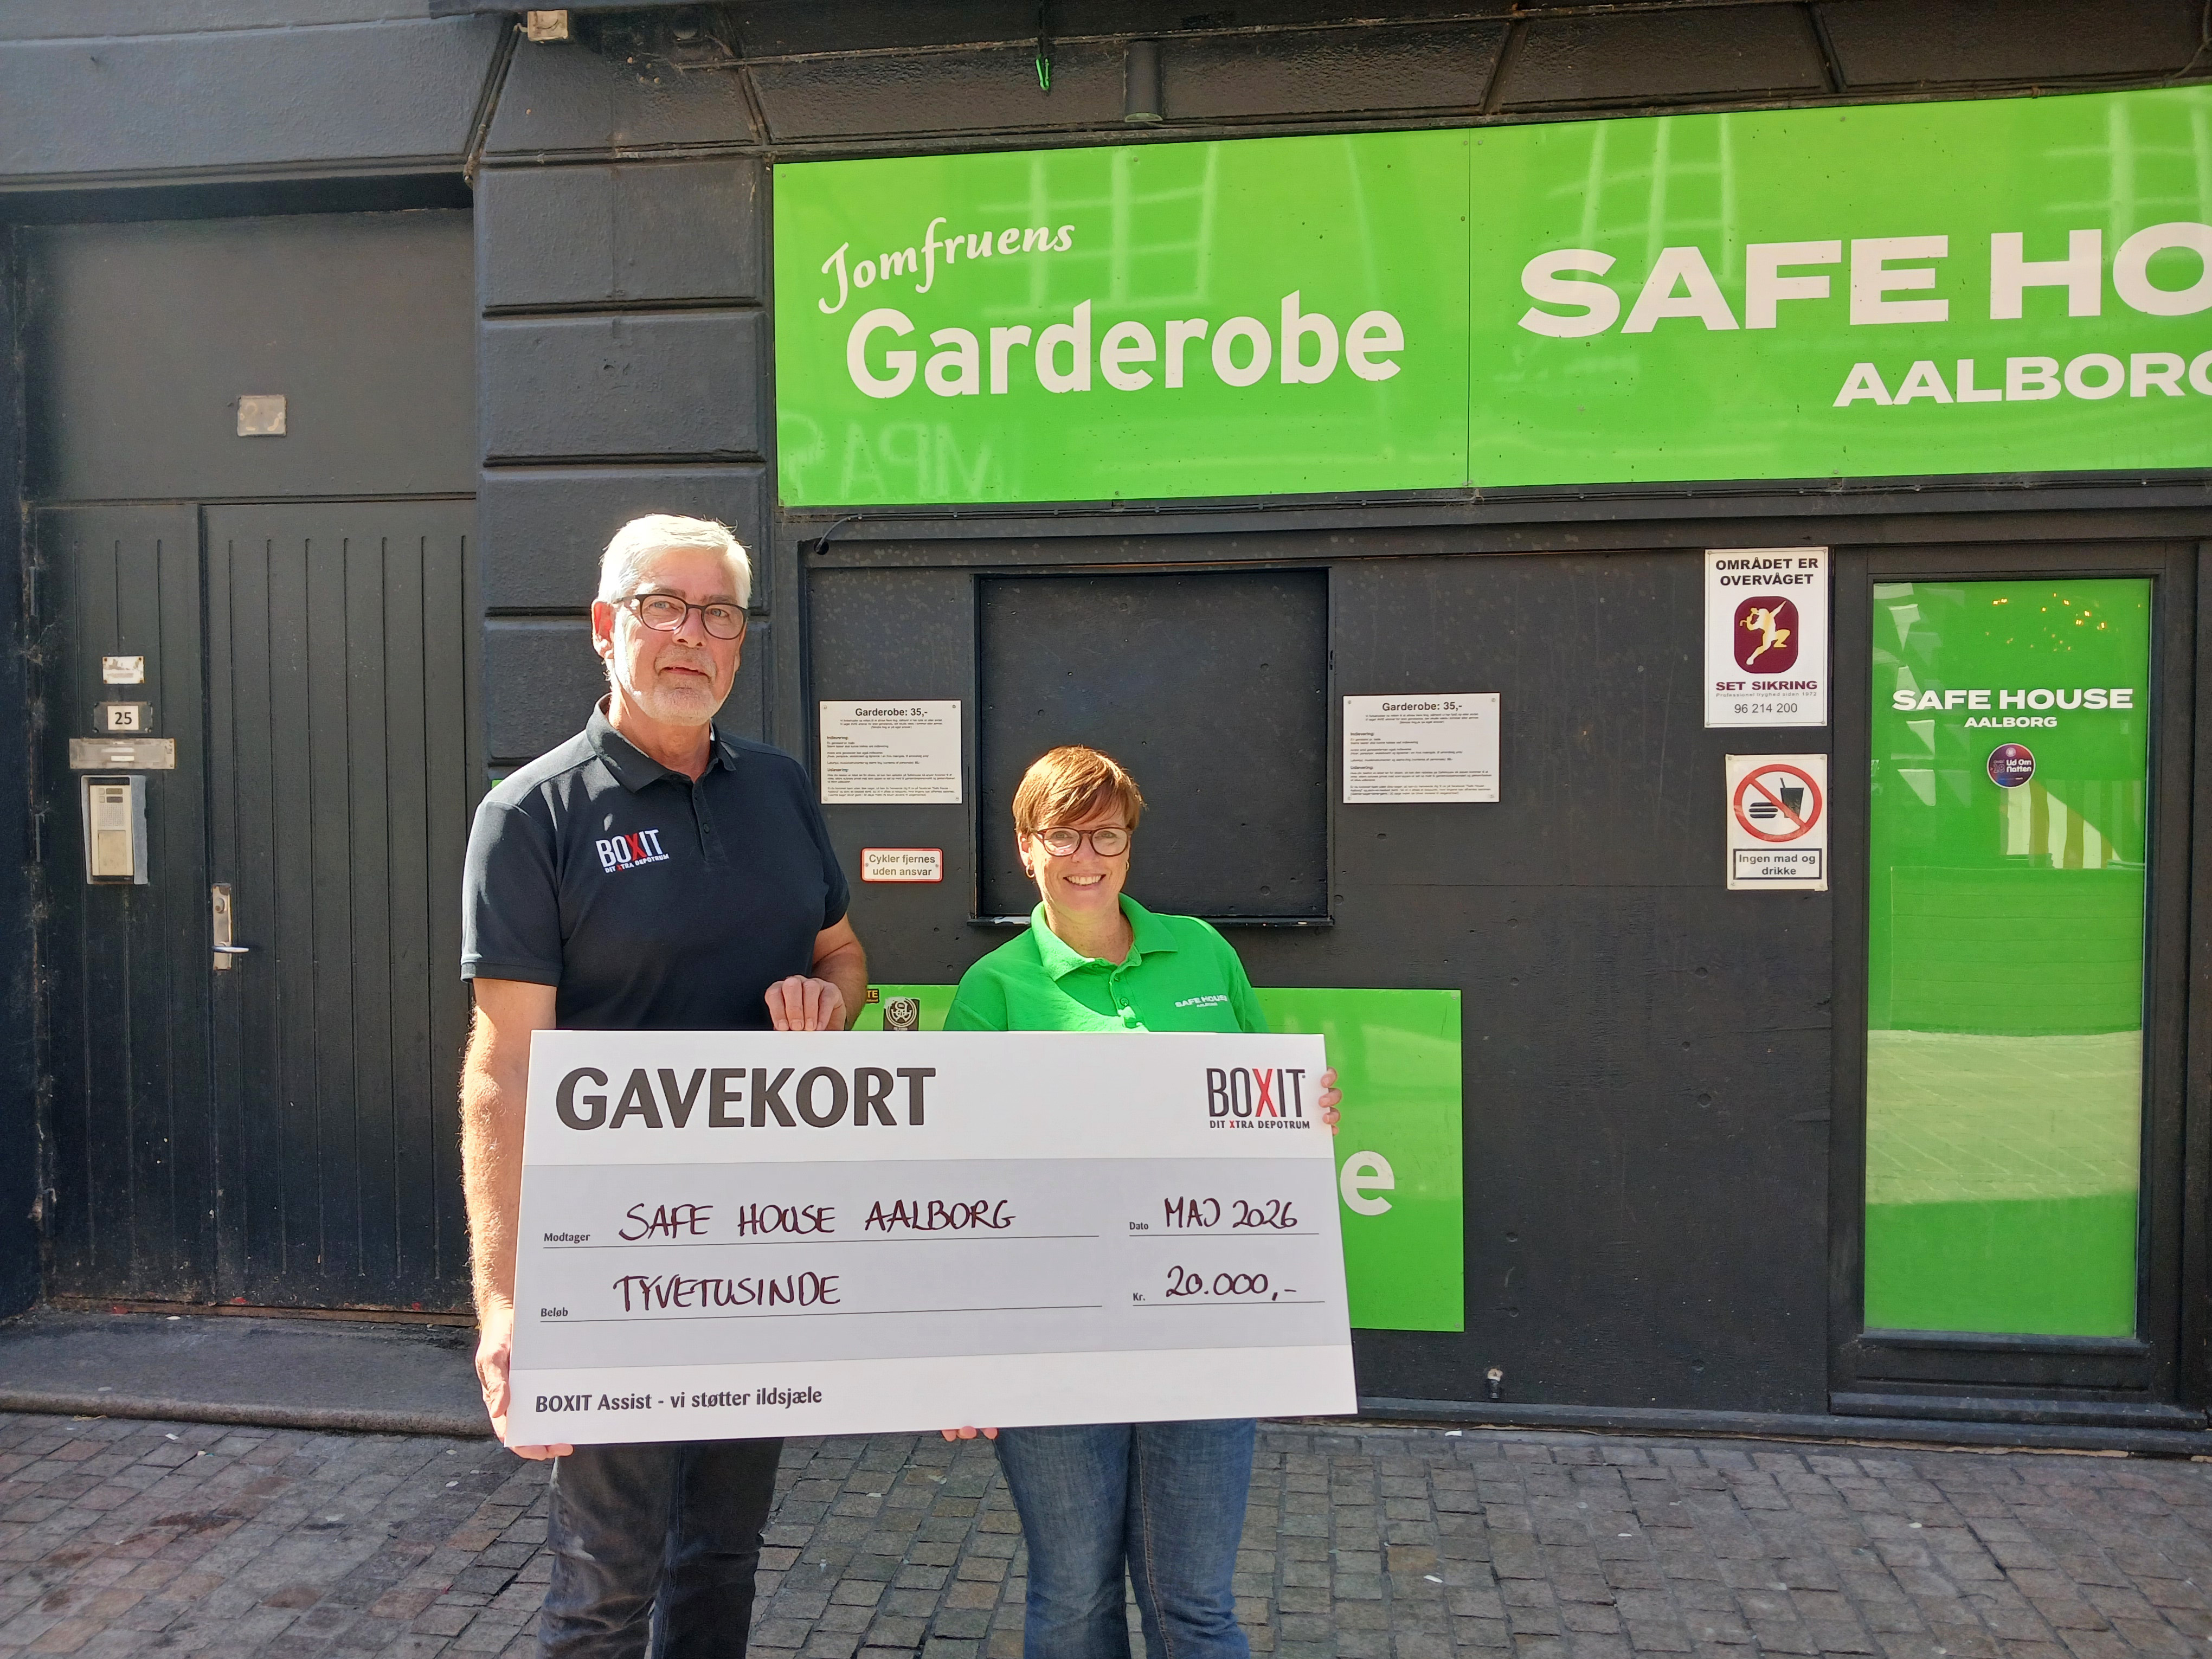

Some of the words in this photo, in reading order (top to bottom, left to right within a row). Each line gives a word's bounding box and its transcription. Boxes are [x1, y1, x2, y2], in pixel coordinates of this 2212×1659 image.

[818, 217, 1075, 314] Jomfruens
[1517, 235, 1949, 339] SAFE
[1990, 221, 2212, 320] HO
[846, 290, 1405, 399] Garderobe
[1716, 557, 1792, 570] OMRÅDET
[1798, 558, 1818, 568] ER
[1720, 573, 1814, 586] OVERVÅGET
[1716, 681, 1746, 691] SET
[1752, 681, 1817, 690] SIKRING
[1892, 690, 1991, 710] SAFE
[1999, 689, 2133, 709] HOUSE
[855, 708, 908, 716] Garderobe:
[910, 708, 928, 717] 35,-
[1382, 702, 1440, 711] Garderobe:
[1443, 702, 1463, 711] 35,-
[1734, 704, 1748, 713] 96
[1752, 703, 1772, 713] 214
[1776, 703, 1798, 712] 200
[114, 711, 132, 725] 25
[1964, 717, 2057, 728] AALBORG
[596, 829, 663, 867] BOXIT
[616, 863, 634, 871] XTRA
[635, 853, 670, 866] DEPOTRUM
[869, 854, 900, 865] Cykler
[902, 854, 936, 865] fjernes
[1739, 854, 1770, 864] Ingen
[1774, 854, 1798, 863] mad
[1802, 855, 1816, 864] og
[872, 867, 896, 876] uden
[1761, 867, 1796, 875] drikke
[1174, 997, 1201, 1007] SAFE
[556, 1066, 936, 1130] GAVEKORT
[1206, 1067, 1305, 1117] BOXIT
[1210, 1120, 1225, 1128] DIT
[1229, 1120, 1254, 1129] XTRA
[1258, 1120, 1310, 1129] DEPOTRUM
[619, 1203, 713, 1240] SAFE
[738, 1203, 835, 1236] HOUSE
[865, 1199, 1016, 1232] AALBORG
[1164, 1197, 1221, 1228] MAJ
[1232, 1199, 1297, 1230] 2026
[1129, 1221, 1149, 1231] Dato
[544, 1231, 590, 1244] Modtager
[1166, 1266, 1297, 1301] 20.000,-
[613, 1271, 841, 1312] TYVETUSINDE
[1133, 1293, 1146, 1301] Kr.
[541, 1307, 569, 1318] Beløb
[536, 1394, 592, 1412] BOXIT
[597, 1393, 652, 1411] Assist
[670, 1392, 685, 1409] vi
[691, 1388, 751, 1407] støtter
[756, 1386, 822, 1409] ildsjæle
